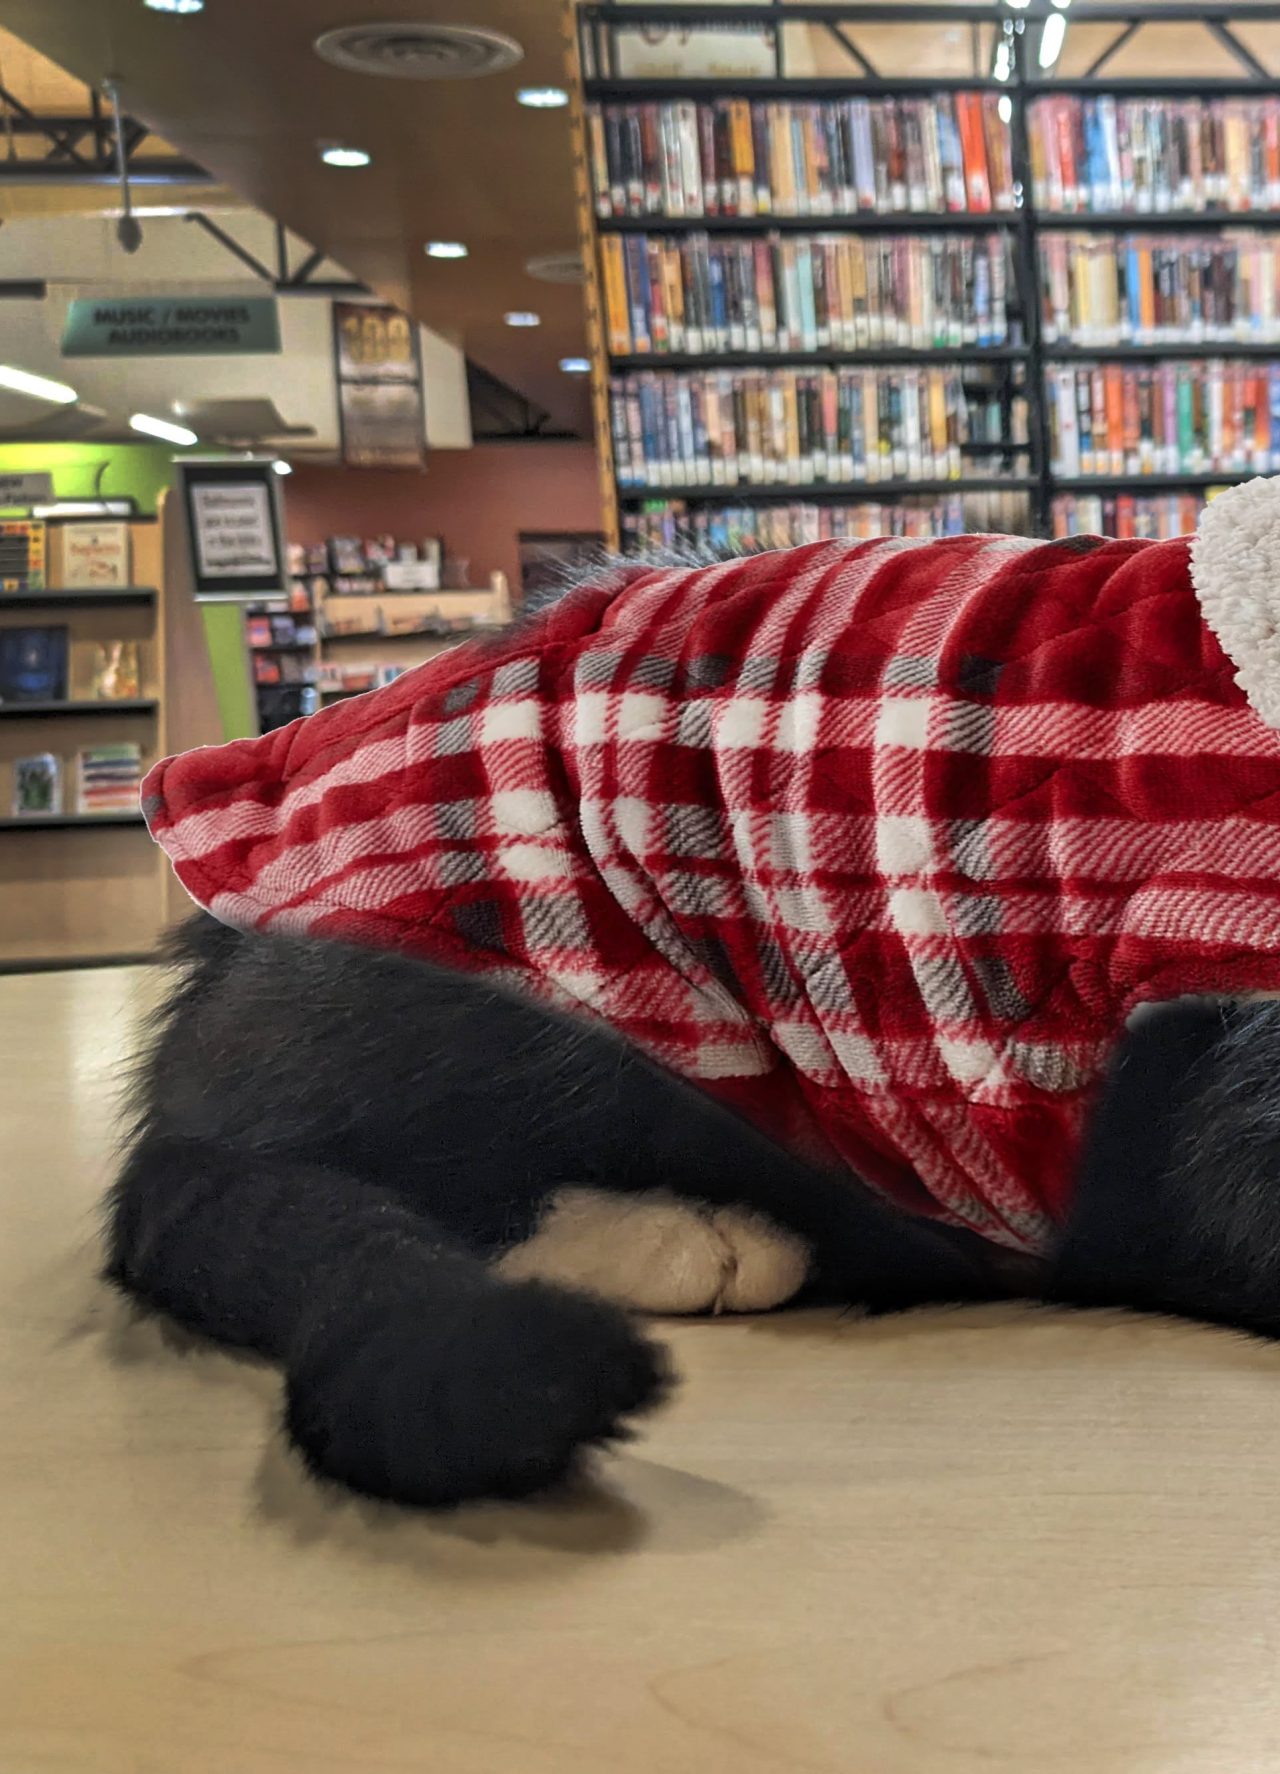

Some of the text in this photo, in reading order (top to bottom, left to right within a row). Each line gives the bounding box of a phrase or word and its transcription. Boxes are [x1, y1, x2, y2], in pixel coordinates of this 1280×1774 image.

[94, 307, 153, 324] MUSIC
[176, 307, 249, 324] MOVIES
[108, 327, 239, 344] AUDIOBOOKS
